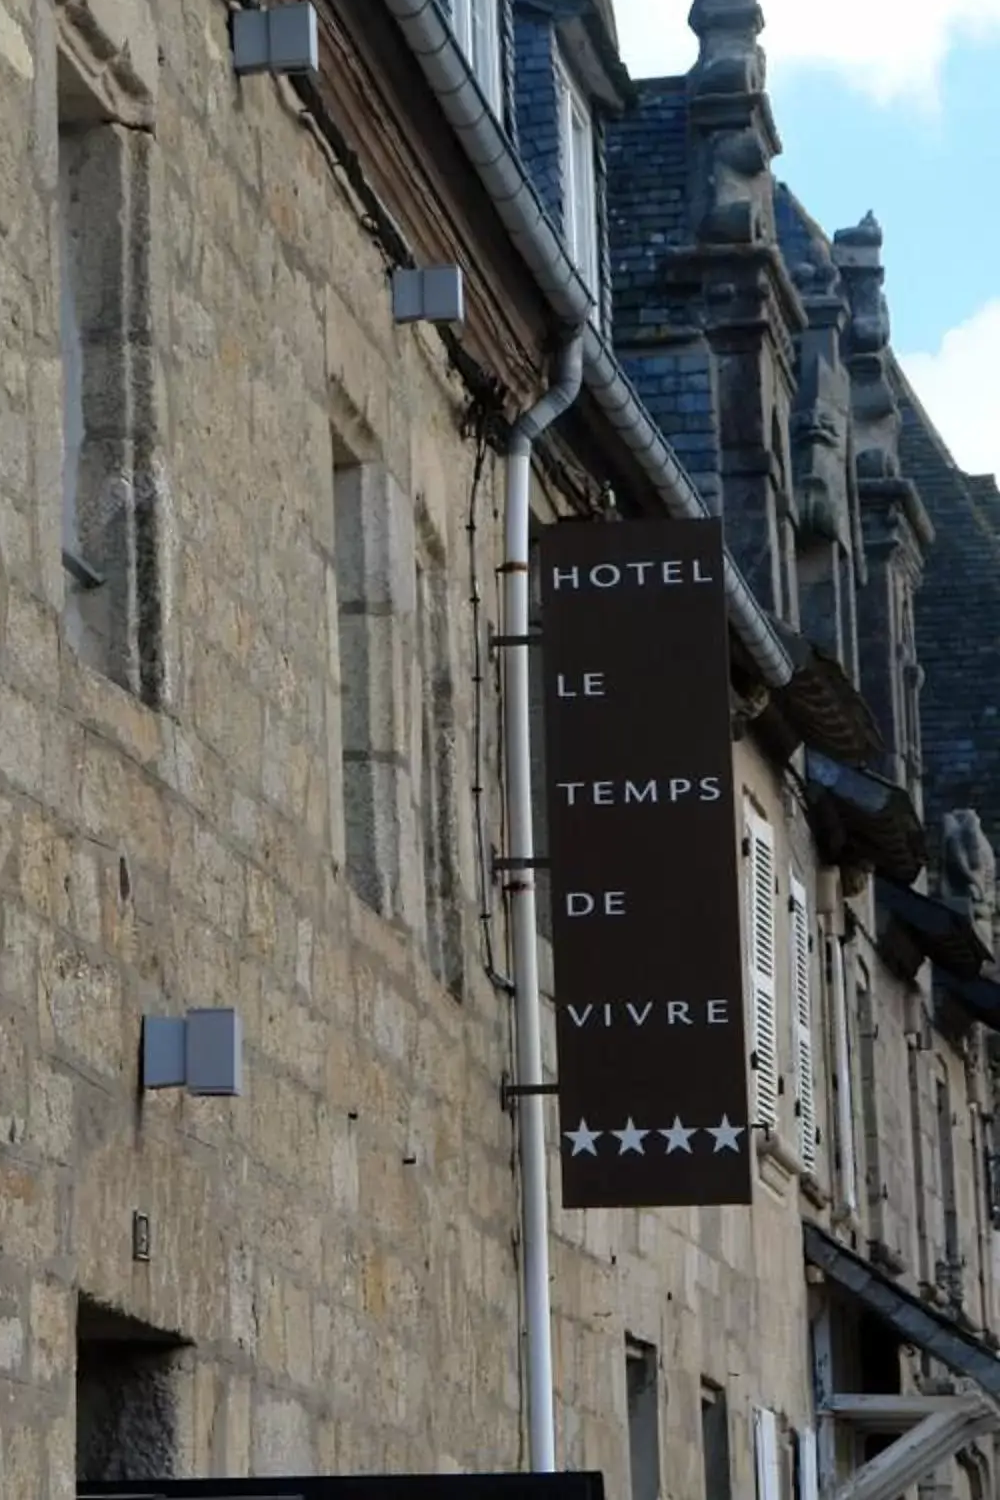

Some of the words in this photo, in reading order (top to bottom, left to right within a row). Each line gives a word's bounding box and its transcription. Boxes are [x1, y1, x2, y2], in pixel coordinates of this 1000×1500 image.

[552, 560, 714, 590] HOTEL
[557, 673, 605, 697] LE
[557, 777, 721, 806] TEMPS
[566, 891, 627, 917] DE
[567, 999, 730, 1028] VIVRE
